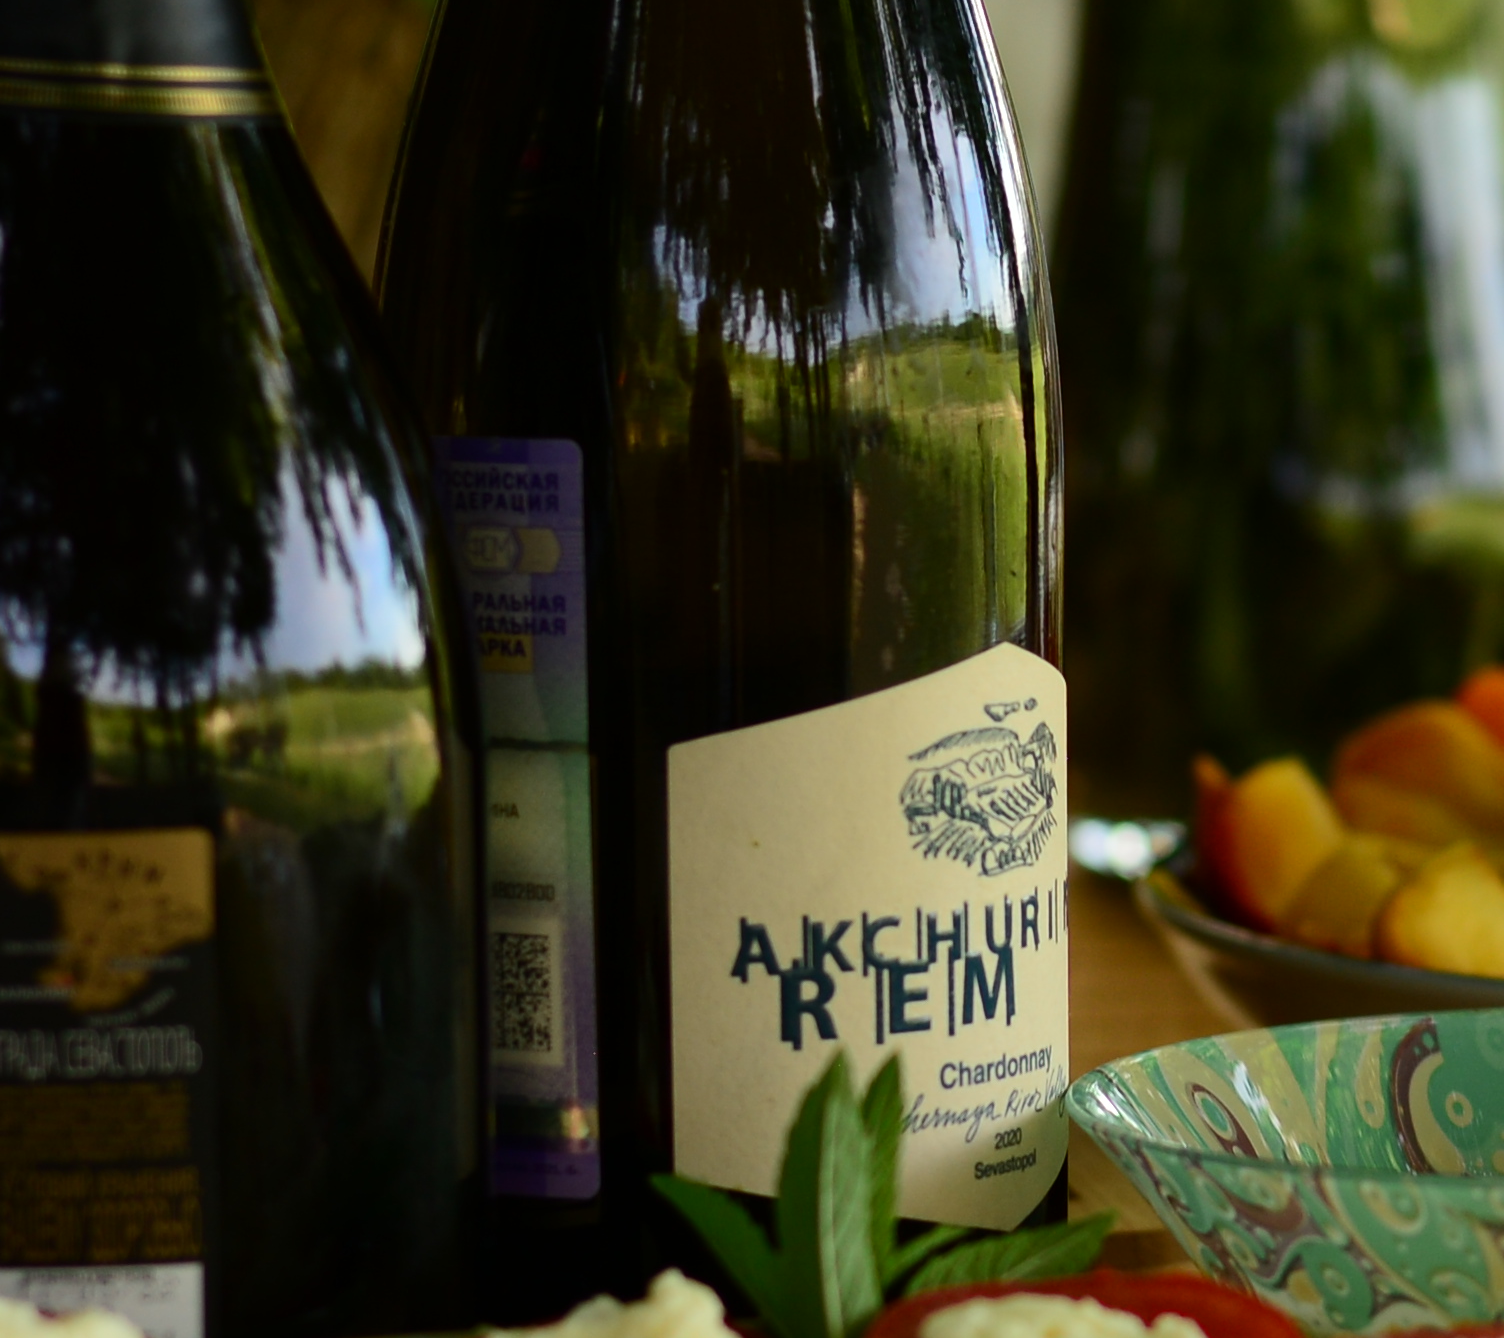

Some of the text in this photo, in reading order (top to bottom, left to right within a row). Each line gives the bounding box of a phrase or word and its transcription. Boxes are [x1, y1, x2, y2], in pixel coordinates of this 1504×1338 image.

[439, 467, 559, 490] ОССИЙСКАЯ
[448, 490, 560, 514] ДЕРАЦИЯ
[472, 591, 566, 613] РАЛЬНАЯ
[779, 947, 1017, 1051] REM
[939, 1045, 1053, 1090] Chardonnay
[901, 1093, 1001, 1144] hernaya
[994, 1127, 1023, 1151] 2020
[973, 1148, 1037, 1180] Sevastopol
